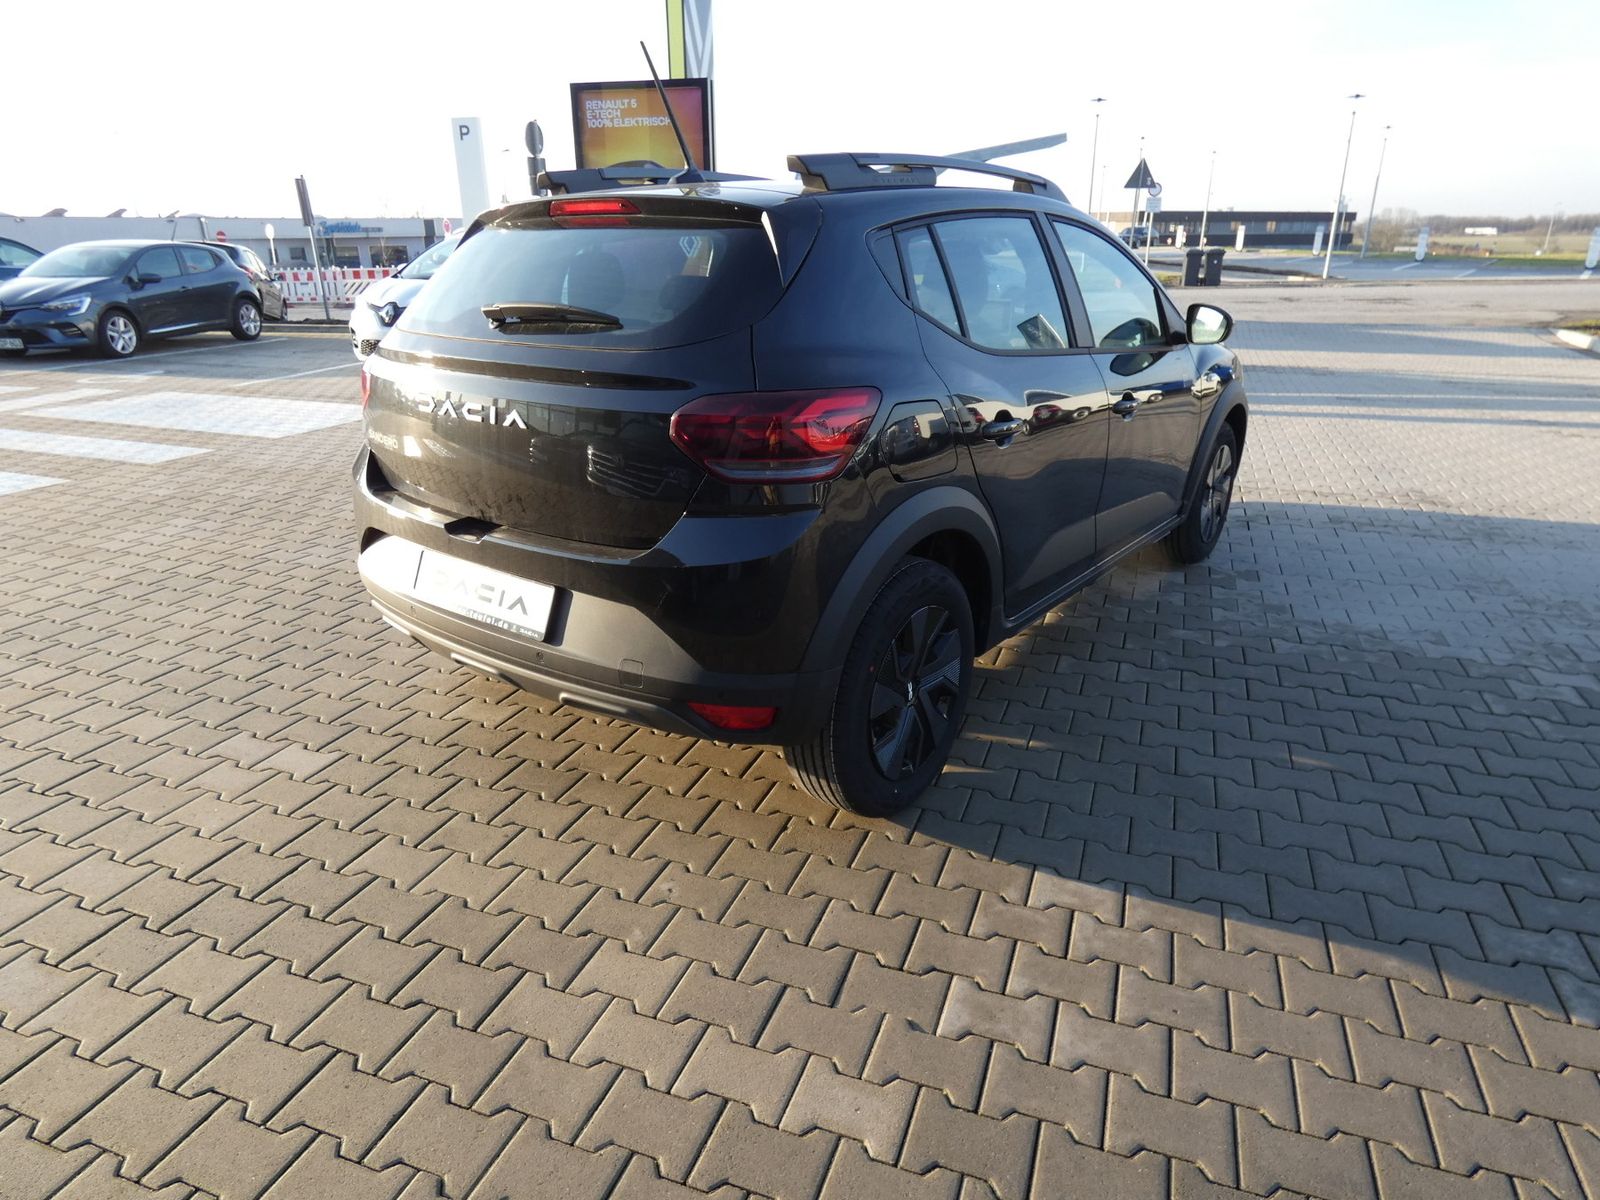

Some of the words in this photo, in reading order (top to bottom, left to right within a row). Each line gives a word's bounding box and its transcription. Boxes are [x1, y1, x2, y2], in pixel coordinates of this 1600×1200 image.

[586, 99, 629, 109] RENAULT
[587, 109, 620, 119] E-TECH
[587, 119, 612, 128] 100%
[613, 116, 671, 127] ELEKTRISCH
[459, 125, 470, 141] P
[417, 394, 527, 429] DACIA
